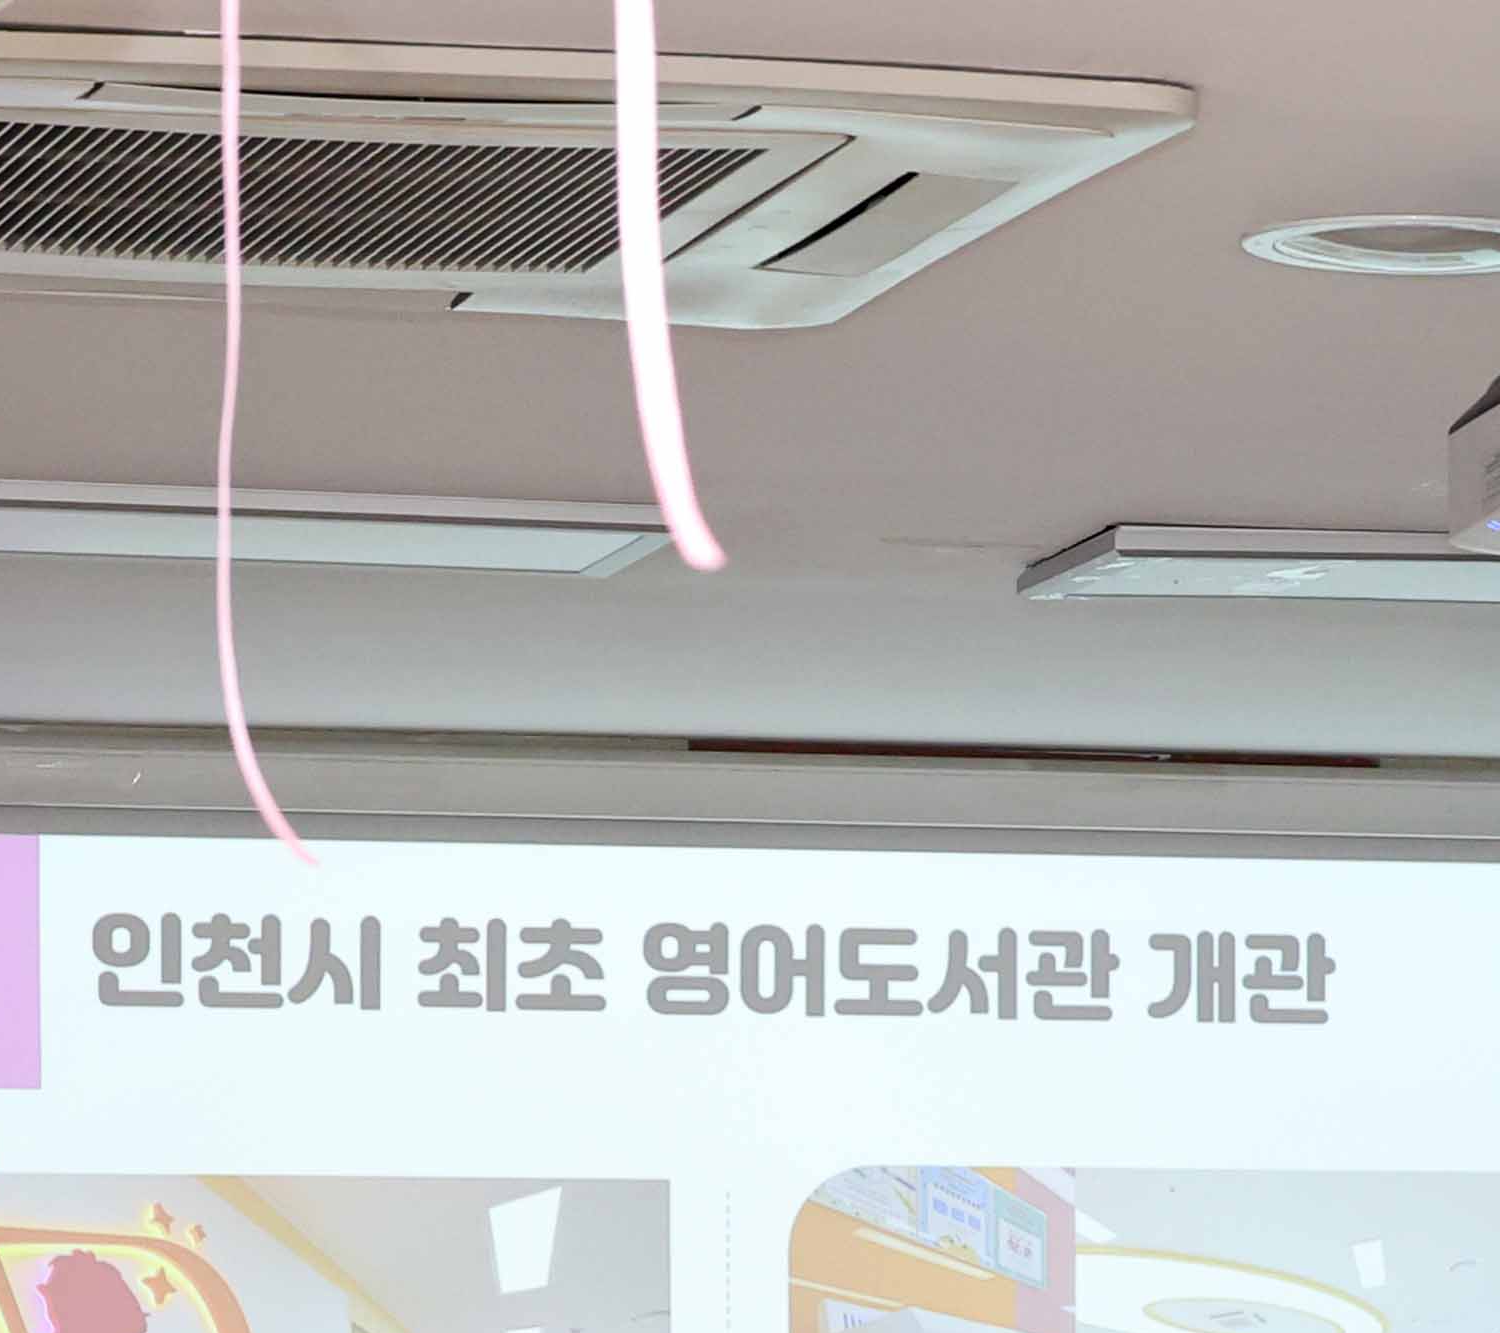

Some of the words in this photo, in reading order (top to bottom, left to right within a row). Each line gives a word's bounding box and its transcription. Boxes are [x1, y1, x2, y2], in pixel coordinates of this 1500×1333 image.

[92, 911, 381, 1012] 인천시
[417, 916, 606, 1013] 최초
[643, 921, 1120, 1022] 영어도서관
[1147, 930, 1336, 1025] 개관
